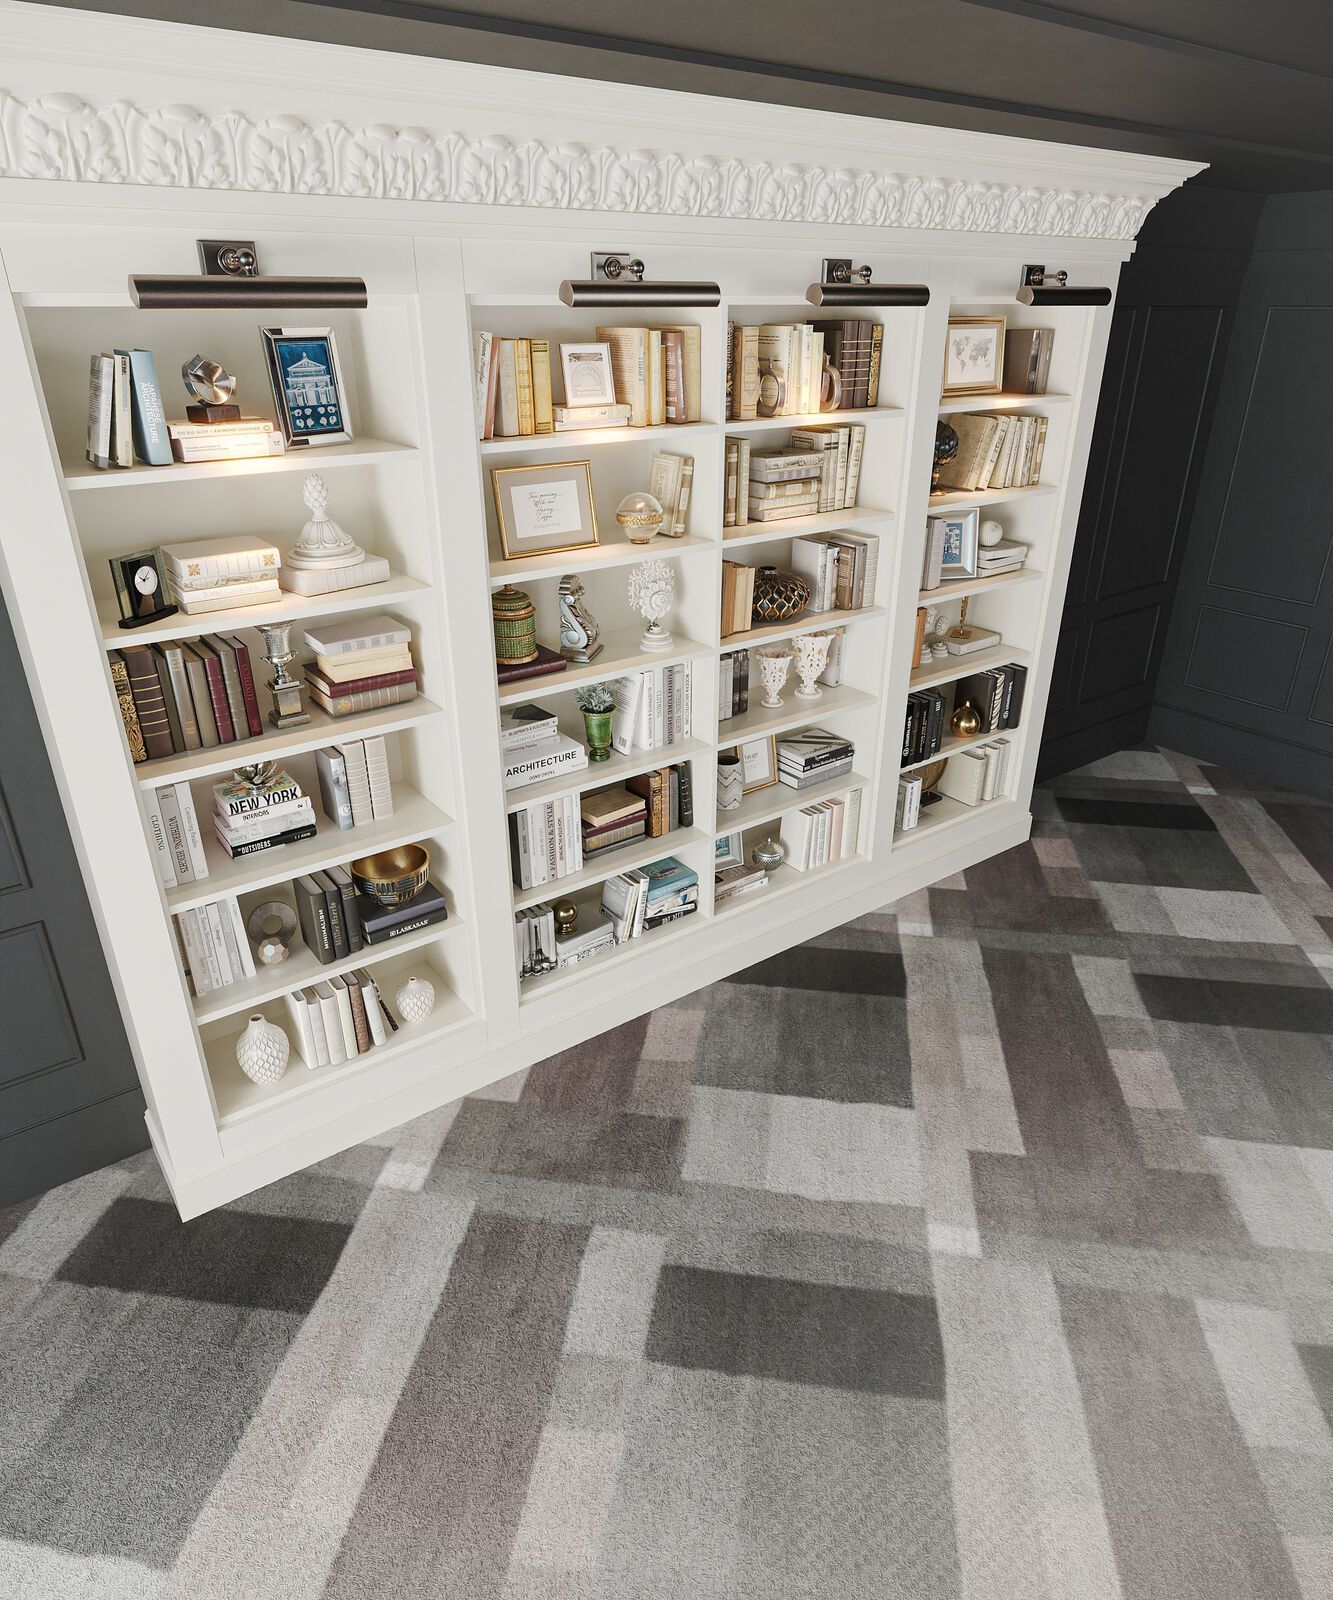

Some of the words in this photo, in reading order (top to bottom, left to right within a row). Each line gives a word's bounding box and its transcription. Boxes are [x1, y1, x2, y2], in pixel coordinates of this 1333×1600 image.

[140, 382, 160, 444] ARCHITECTURE
[147, 382, 162, 423] JAPANESE
[506, 750, 577, 778] ARCHITECTURE
[229, 797, 260, 815] NEW
[262, 787, 298, 806] YORK
[242, 809, 270, 821] INTERIORS
[151, 815, 165, 851] CLOTHING
[168, 815, 184, 850] WUTHERING
[176, 849, 189, 874] HEIGHTS
[241, 840, 271, 854] OUTSIDERS
[318, 909, 329, 950] MINIMALISM
[395, 919, 429, 937] LASKASAS
